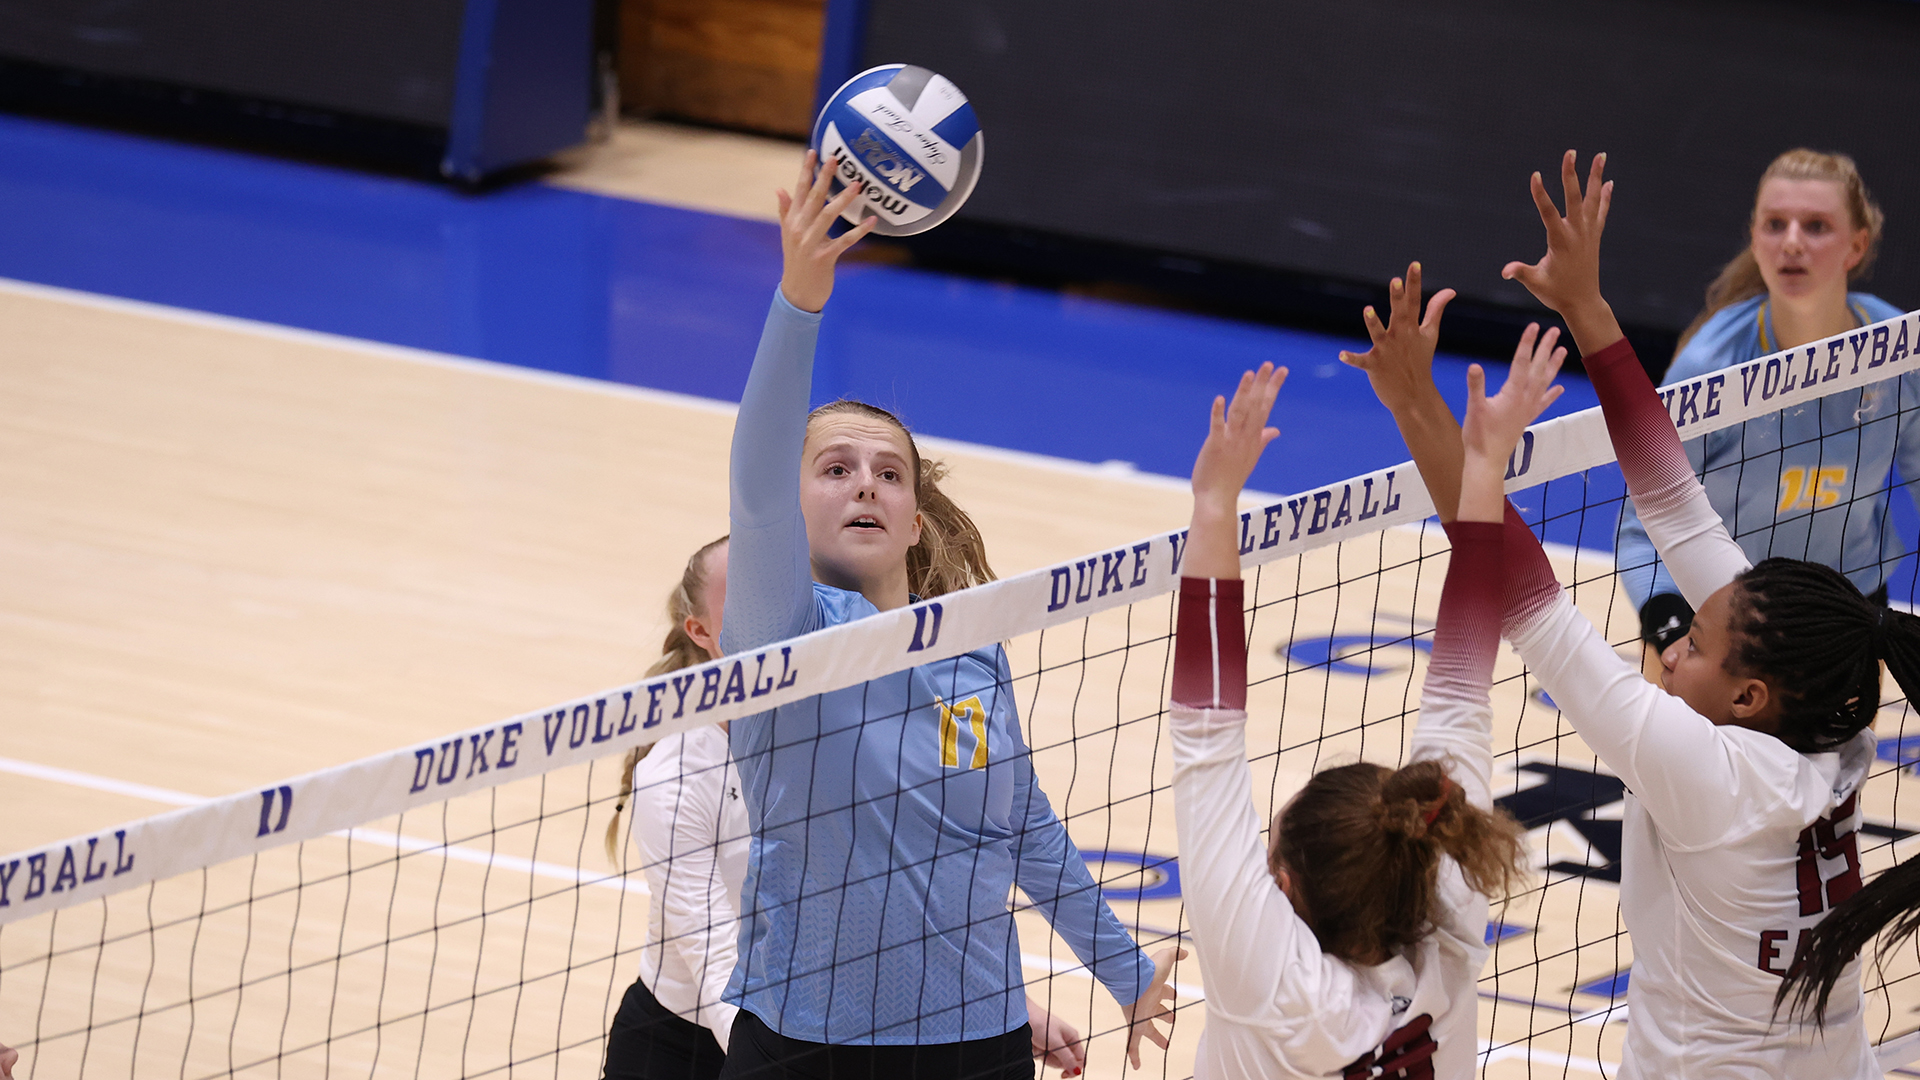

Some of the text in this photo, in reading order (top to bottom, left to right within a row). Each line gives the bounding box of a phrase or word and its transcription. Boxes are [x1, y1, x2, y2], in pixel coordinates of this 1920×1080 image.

[854, 127, 925, 193] NCAA
[1777, 465, 1847, 516] 15
[409, 722, 522, 794] DUKE
[543, 647, 798, 756] VOLLEYBALL
[1047, 543, 1149, 613] DUKE
[1168, 471, 1401, 576] VLEYBALL
[933, 695, 991, 772] 17
[1797, 790, 1863, 918] 15
